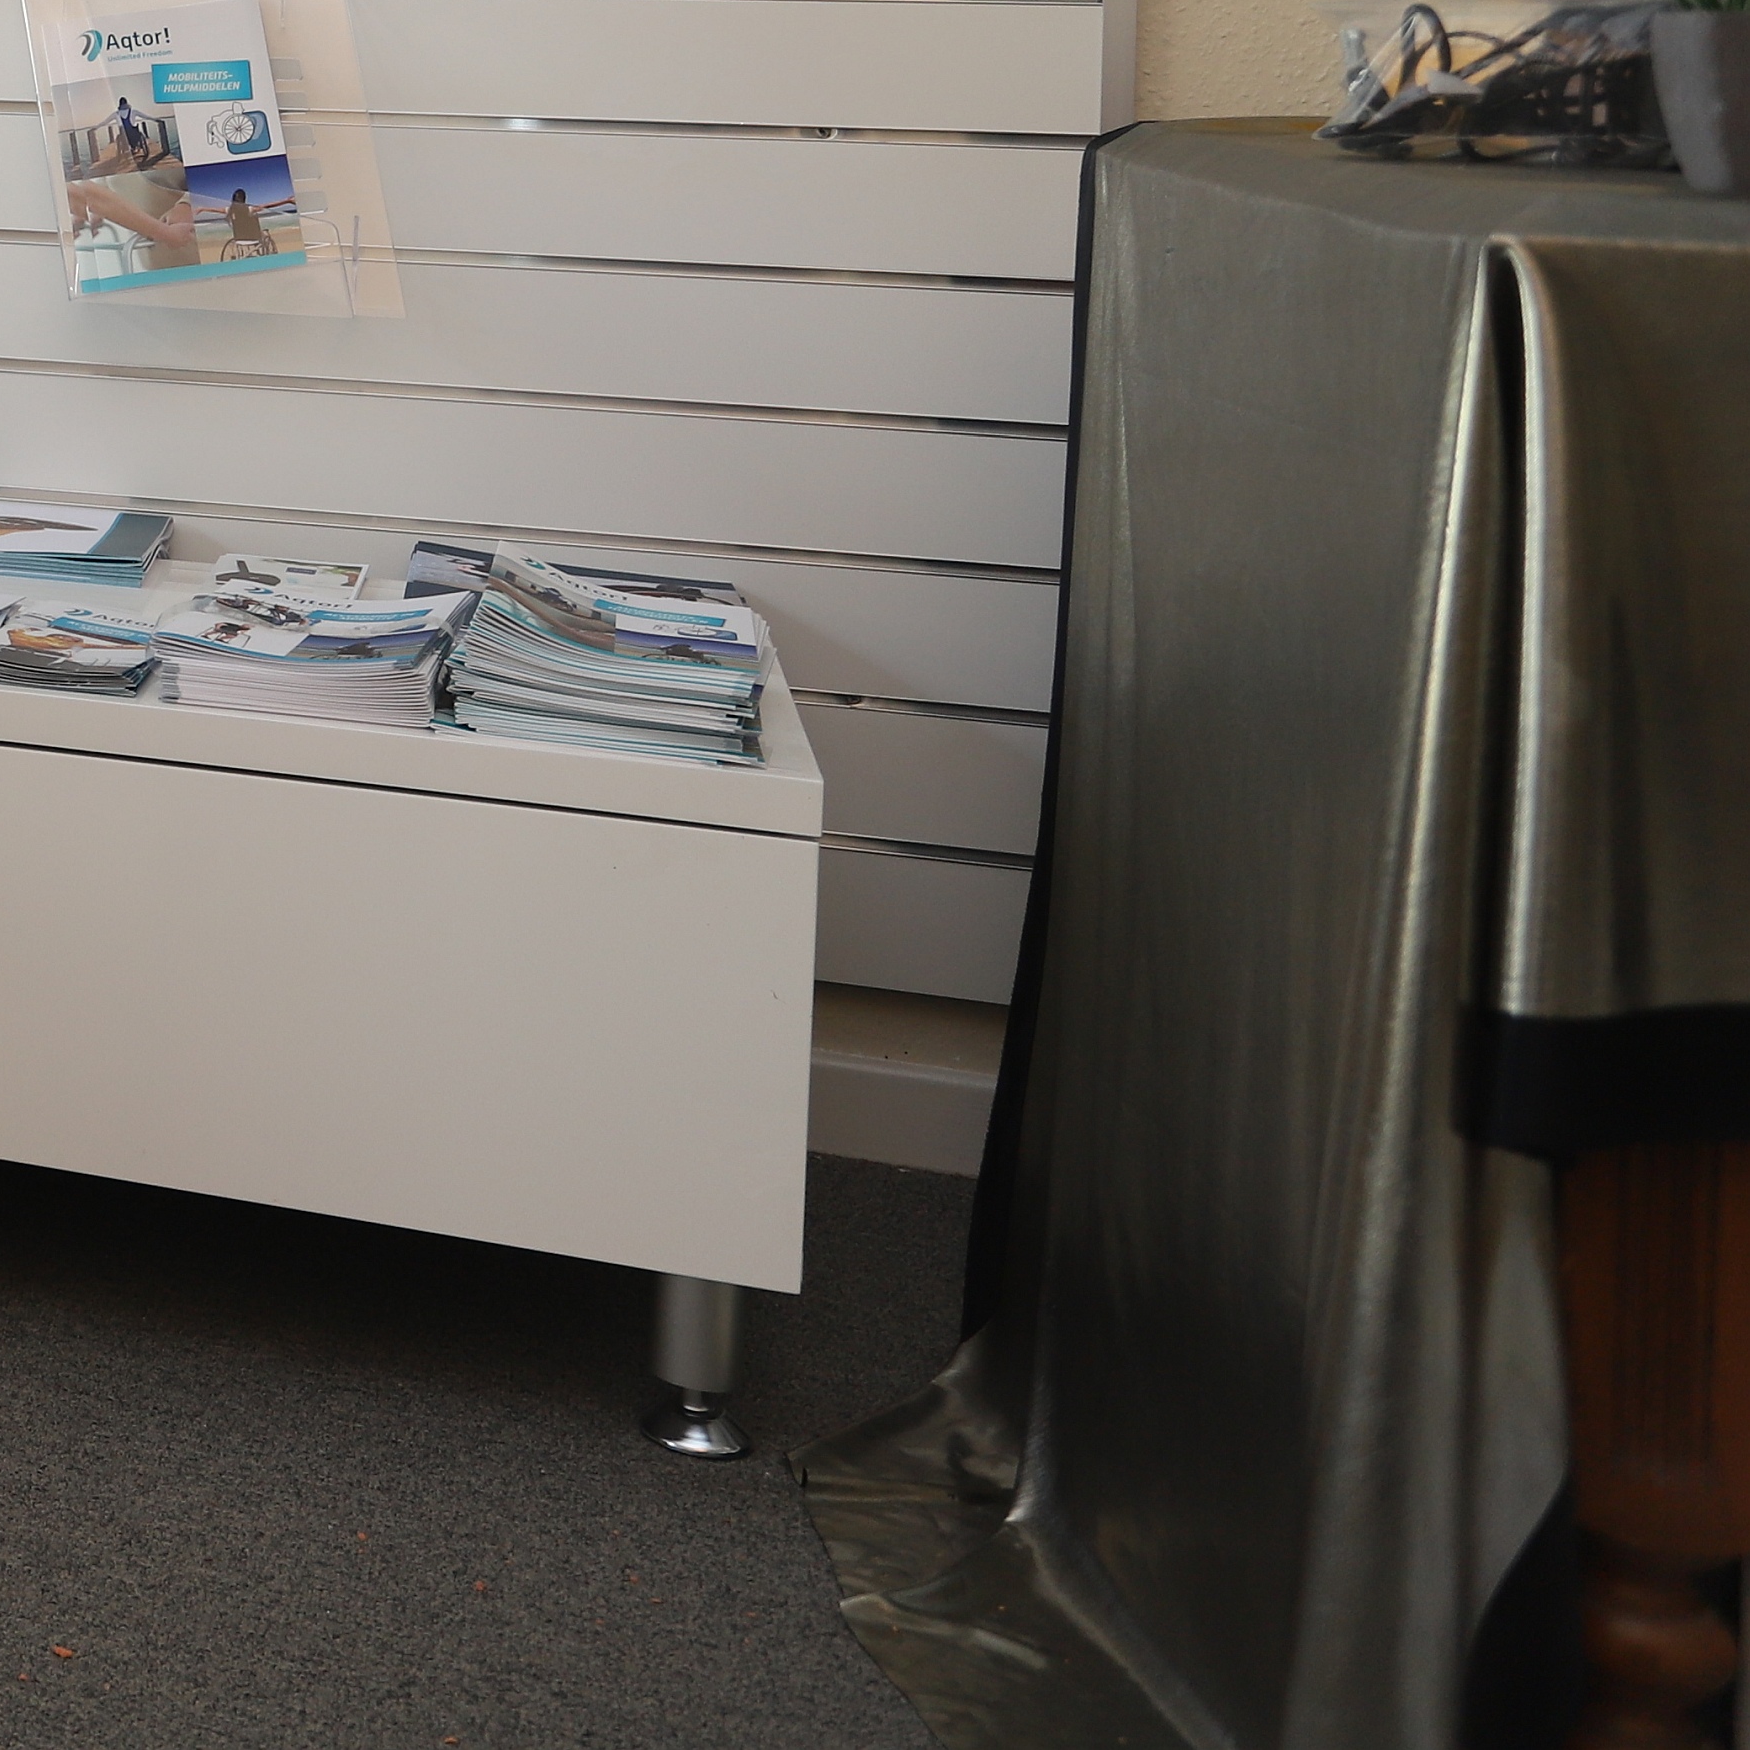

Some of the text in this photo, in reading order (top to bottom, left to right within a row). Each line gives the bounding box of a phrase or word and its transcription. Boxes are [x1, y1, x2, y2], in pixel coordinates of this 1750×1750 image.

[106, 27, 171, 52] Aqtor!
[107, 49, 173, 63] Unlimited Freedom
[168, 70, 233, 82] MOBILITEITS-
[163, 81, 241, 93] HULPMIDDELEN
